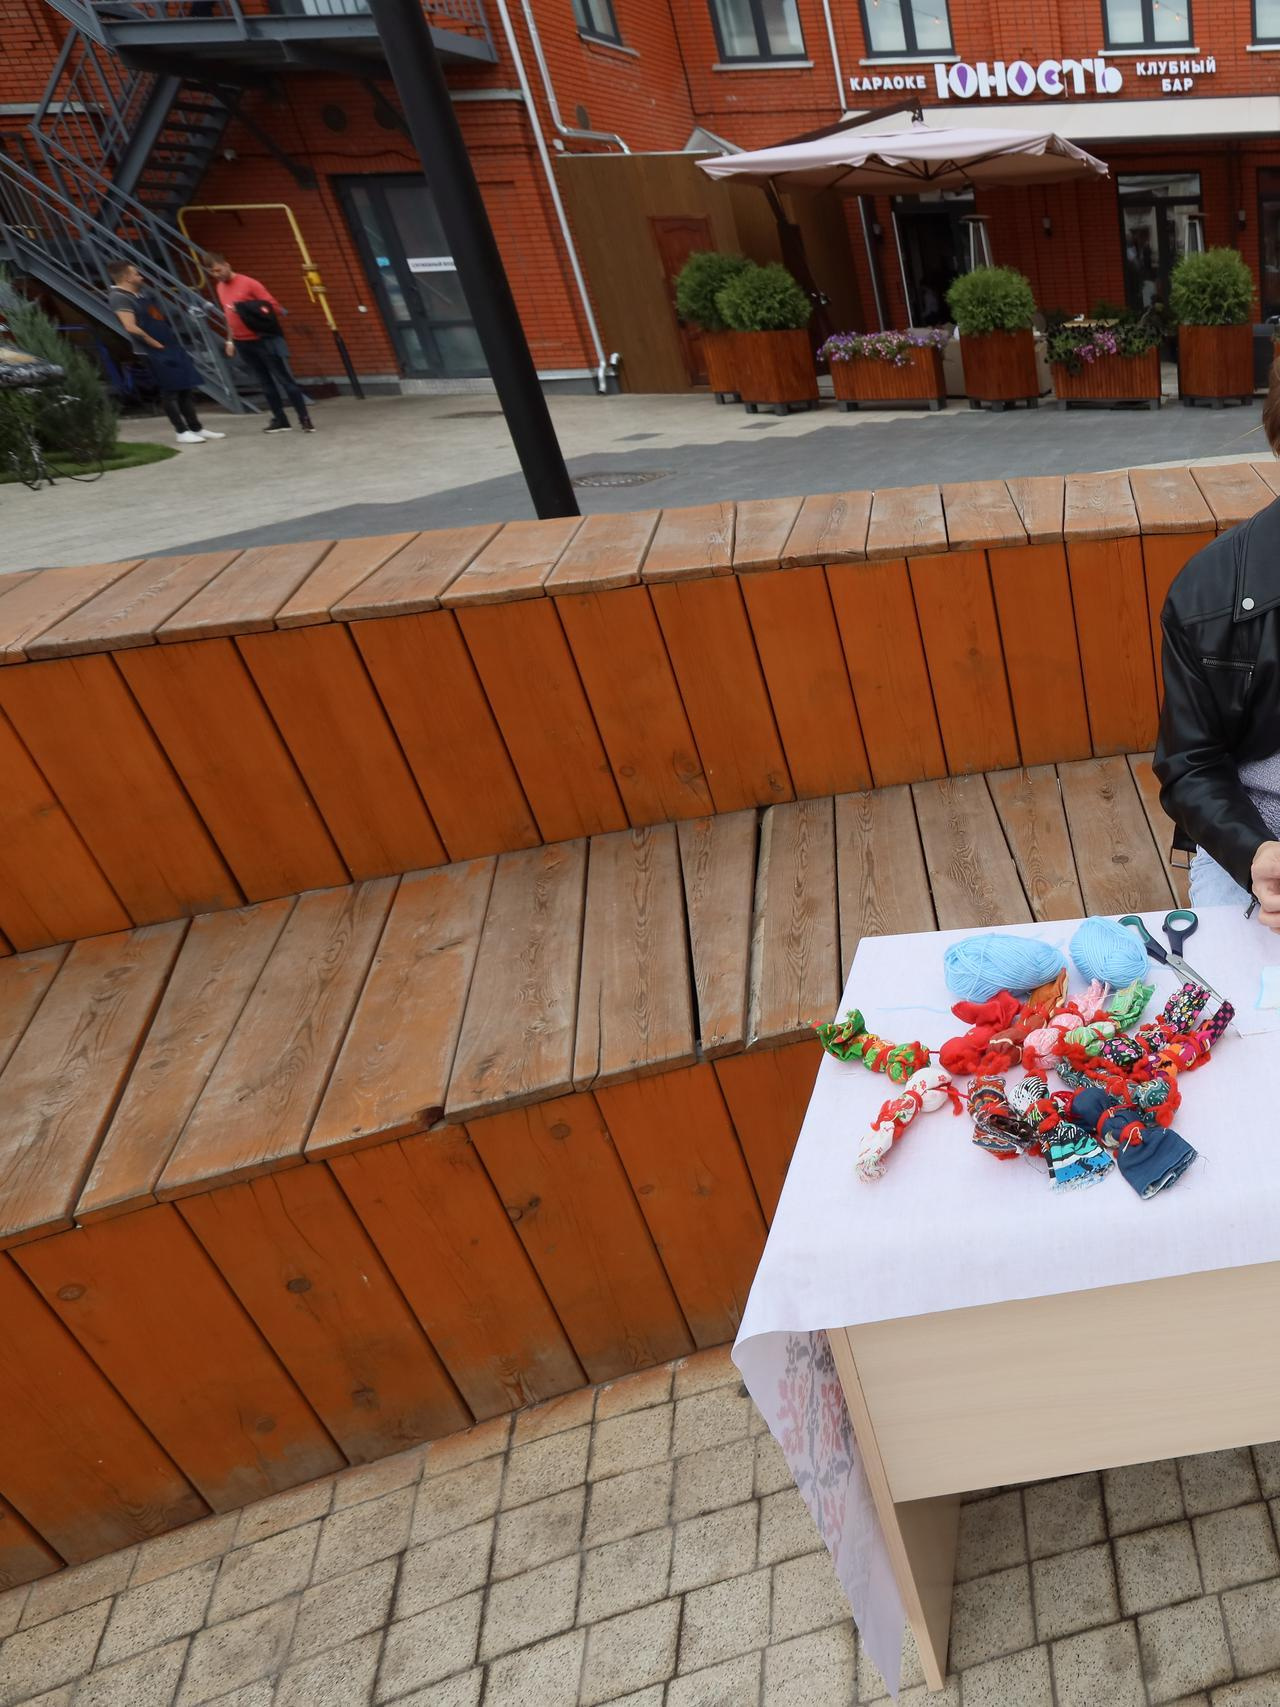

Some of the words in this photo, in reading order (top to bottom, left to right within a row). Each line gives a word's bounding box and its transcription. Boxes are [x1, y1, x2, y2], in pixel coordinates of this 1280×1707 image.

[1136, 56, 1216, 76] КЛУБНЫЙ
[850, 74, 926, 91] КАРАОКЕ
[934, 57, 1123, 99] ЮНОСТЬ
[1161, 78, 1194, 92] БАР
